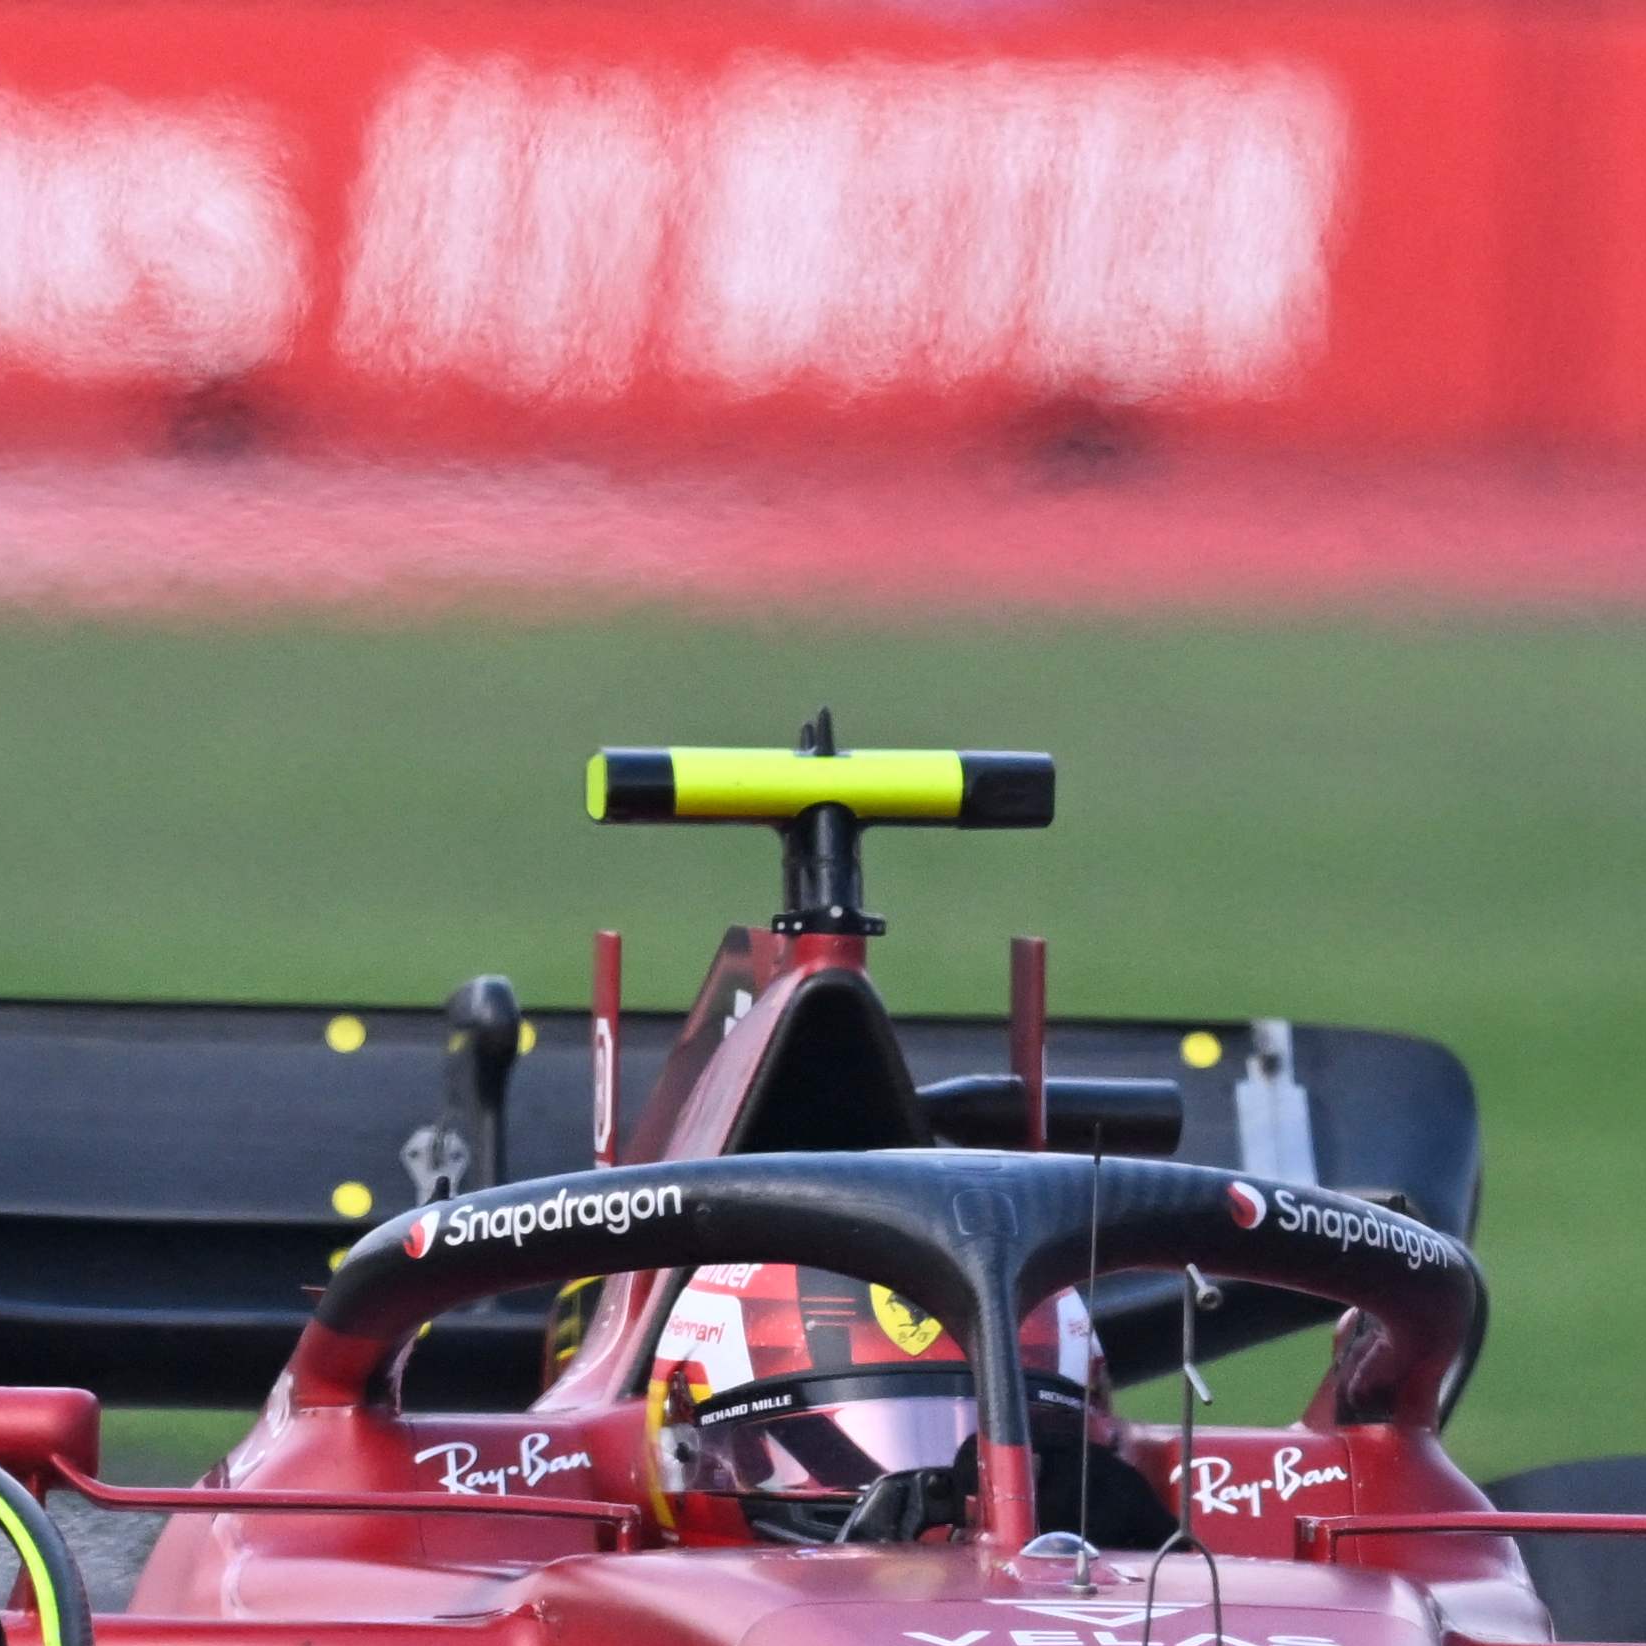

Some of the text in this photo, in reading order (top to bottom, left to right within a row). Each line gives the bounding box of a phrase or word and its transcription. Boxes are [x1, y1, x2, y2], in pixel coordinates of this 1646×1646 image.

[444, 1185, 681, 1247] Snapdragon
[1274, 1189, 1448, 1270] Snapdragon
[700, 1394, 793, 1426] RICHARD MILLE
[414, 1433, 592, 1496] Ray-Ban
[1169, 1446, 1348, 1518] Ray-Ban
